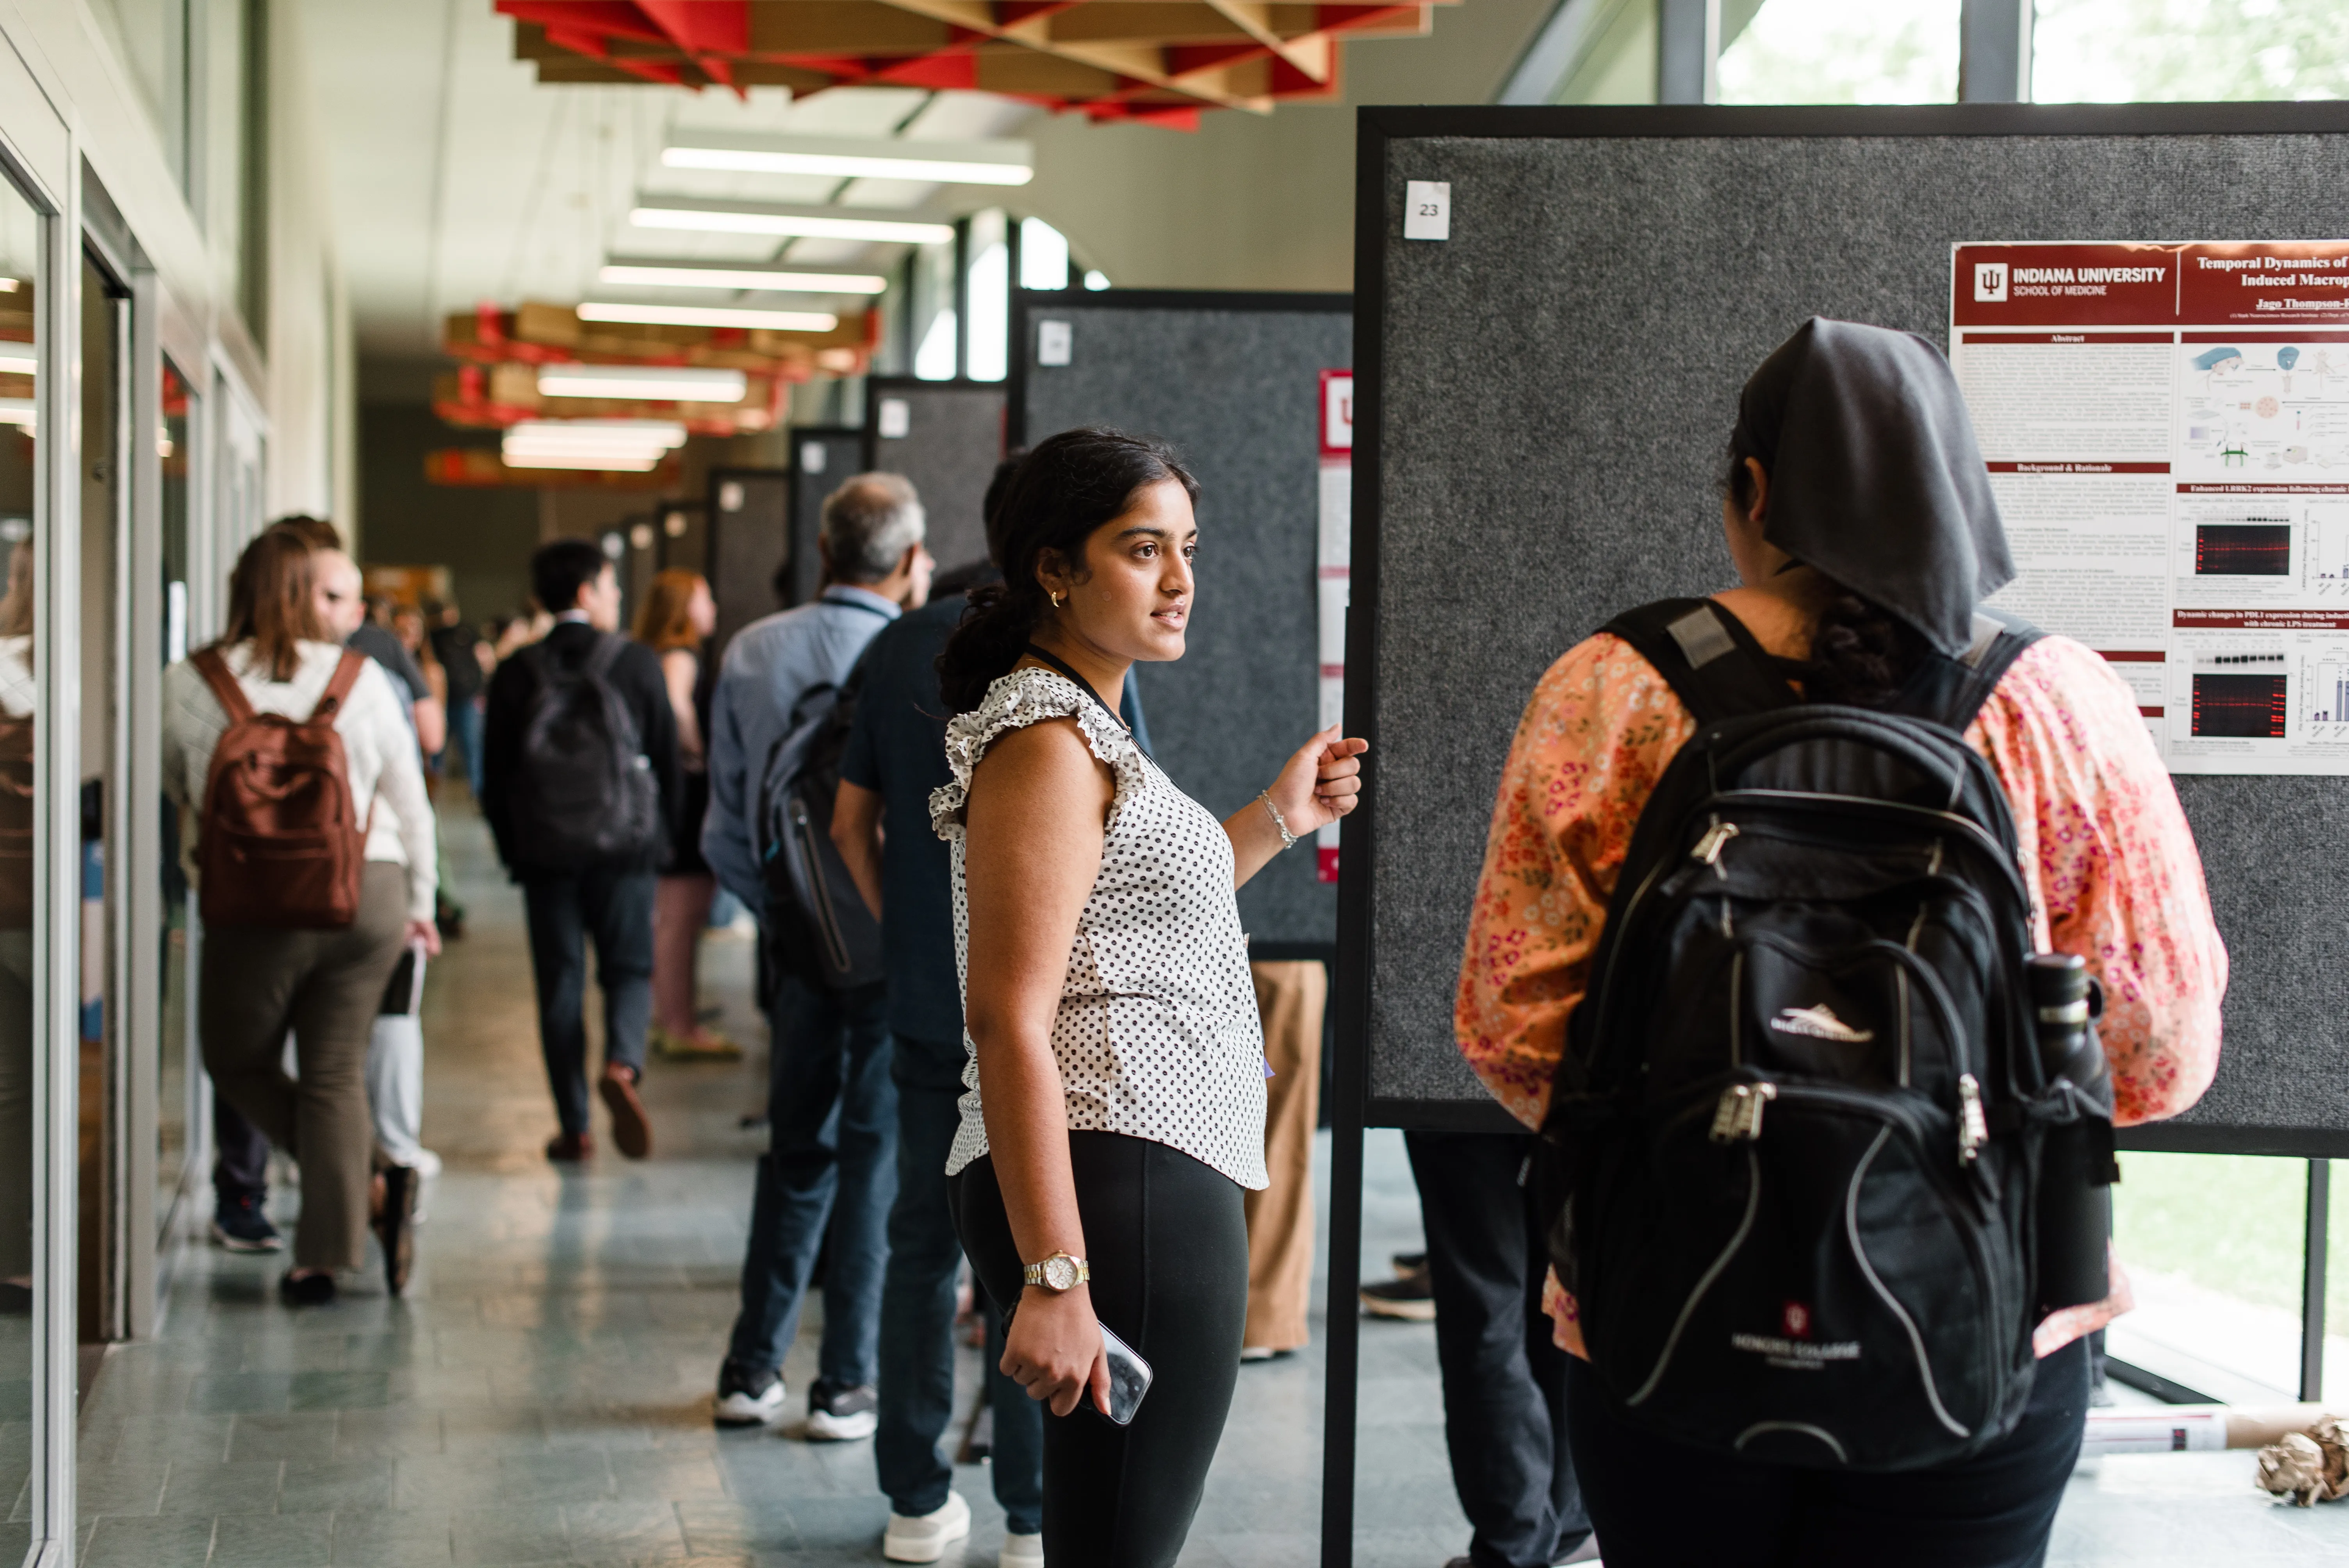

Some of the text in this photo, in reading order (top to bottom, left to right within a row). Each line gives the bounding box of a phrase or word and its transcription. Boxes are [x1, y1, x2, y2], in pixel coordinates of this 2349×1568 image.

[1420, 204, 1438, 216] 23
[2197, 256, 2349, 272] Temporal Dynamics of
[2013, 267, 2166, 283] INDIANA UNIVERSITY
[2241, 274, 2296, 286] Induced
[2013, 285, 2107, 296] SCHOOL OF MEDICINE
[2256, 298, 2282, 310] Jago
[2051, 335, 2085, 344] Abstract
[2017, 463, 2112, 473] Background & Rationale
[2177, 610, 2207, 619] Dynamic
[2208, 610, 2235, 620] changes
[2265, 612, 2300, 620] expression
[2301, 612, 2325, 620] during
